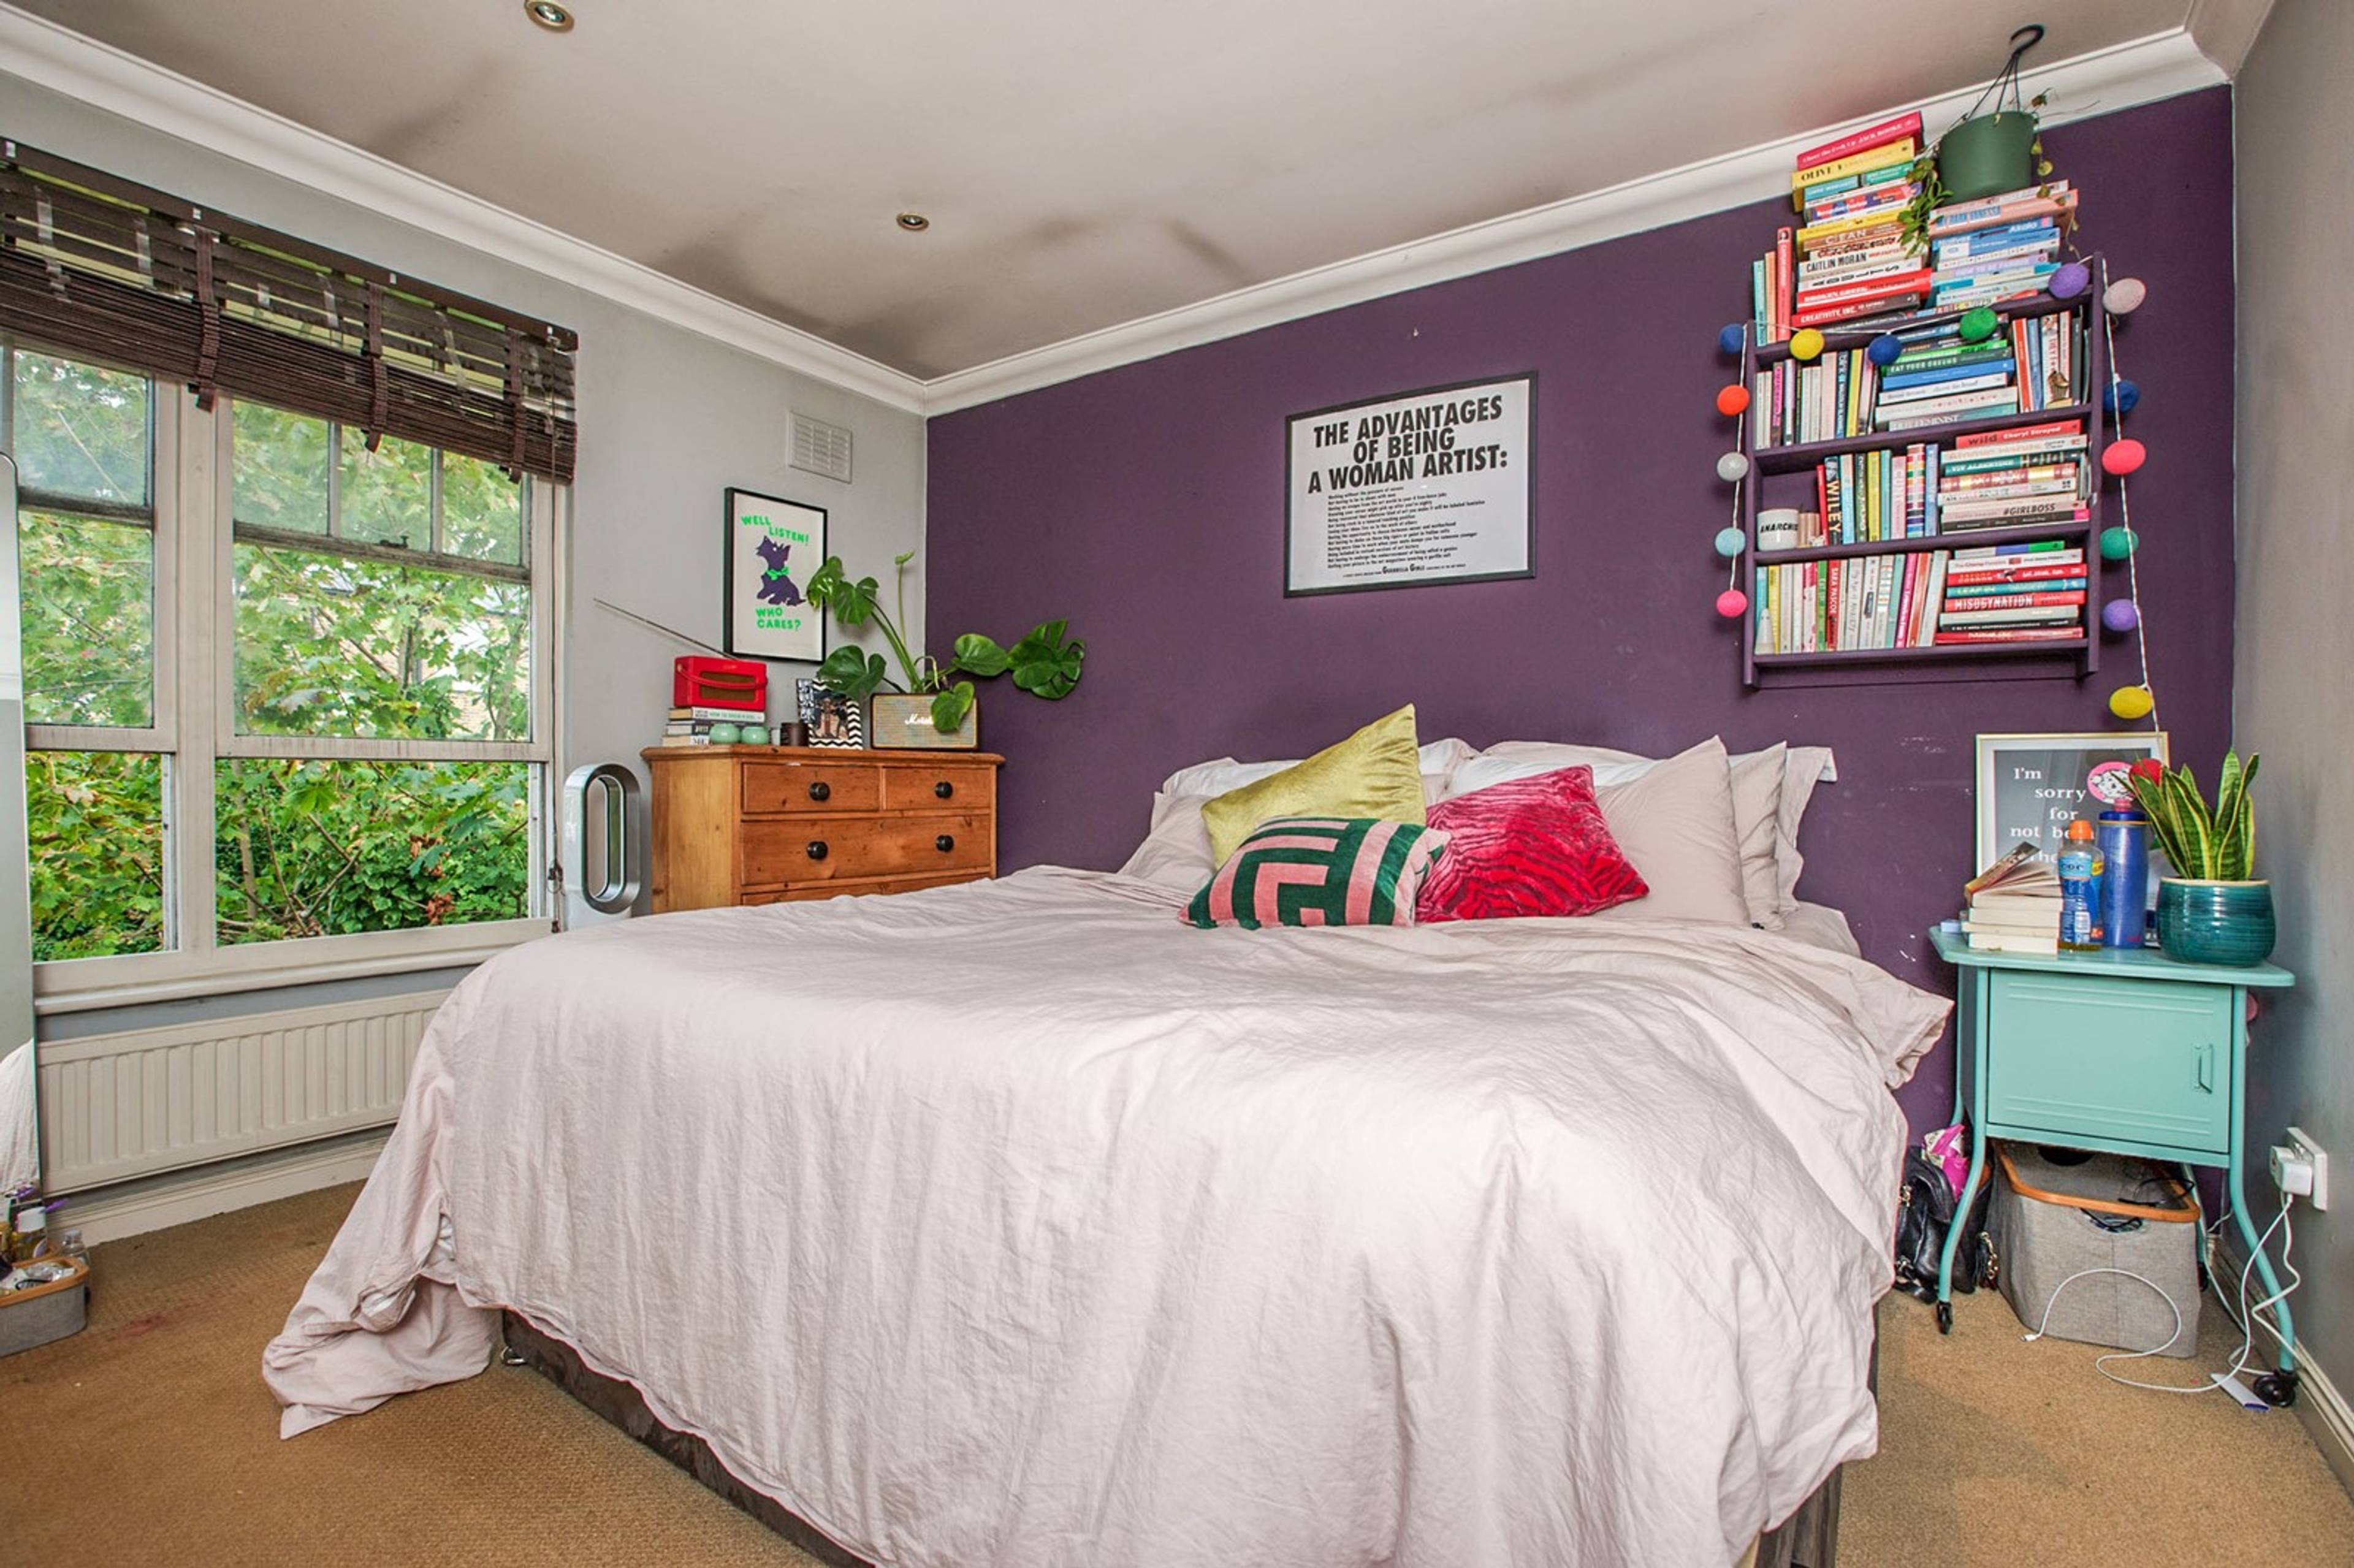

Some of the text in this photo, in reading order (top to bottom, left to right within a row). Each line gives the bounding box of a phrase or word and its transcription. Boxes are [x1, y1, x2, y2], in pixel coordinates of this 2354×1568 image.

[1806, 252, 1867, 273] CAITLIN MORAN
[1314, 395, 1502, 448] THE ADVANTAGES
[1354, 428, 1455, 464] OF BEING
[1308, 444, 1508, 493] A WOMAN ARTIST:
[1826, 481, 1842, 533] WILEY
[2003, 503, 2056, 516] #GIRLBOSS
[741, 515, 771, 525] WELL
[769, 526, 809, 546] LISTEN!
[1830, 568, 1839, 587] SARA
[1954, 596, 2033, 610] MISOGYNATION
[755, 607, 783, 617] WHO
[756, 618, 802, 632] CARES?
[2013, 767, 2041, 780] I'm
[2035, 788, 2087, 802] sorry
[2049, 807, 2078, 820] for
[2010, 826, 2040, 837] not
